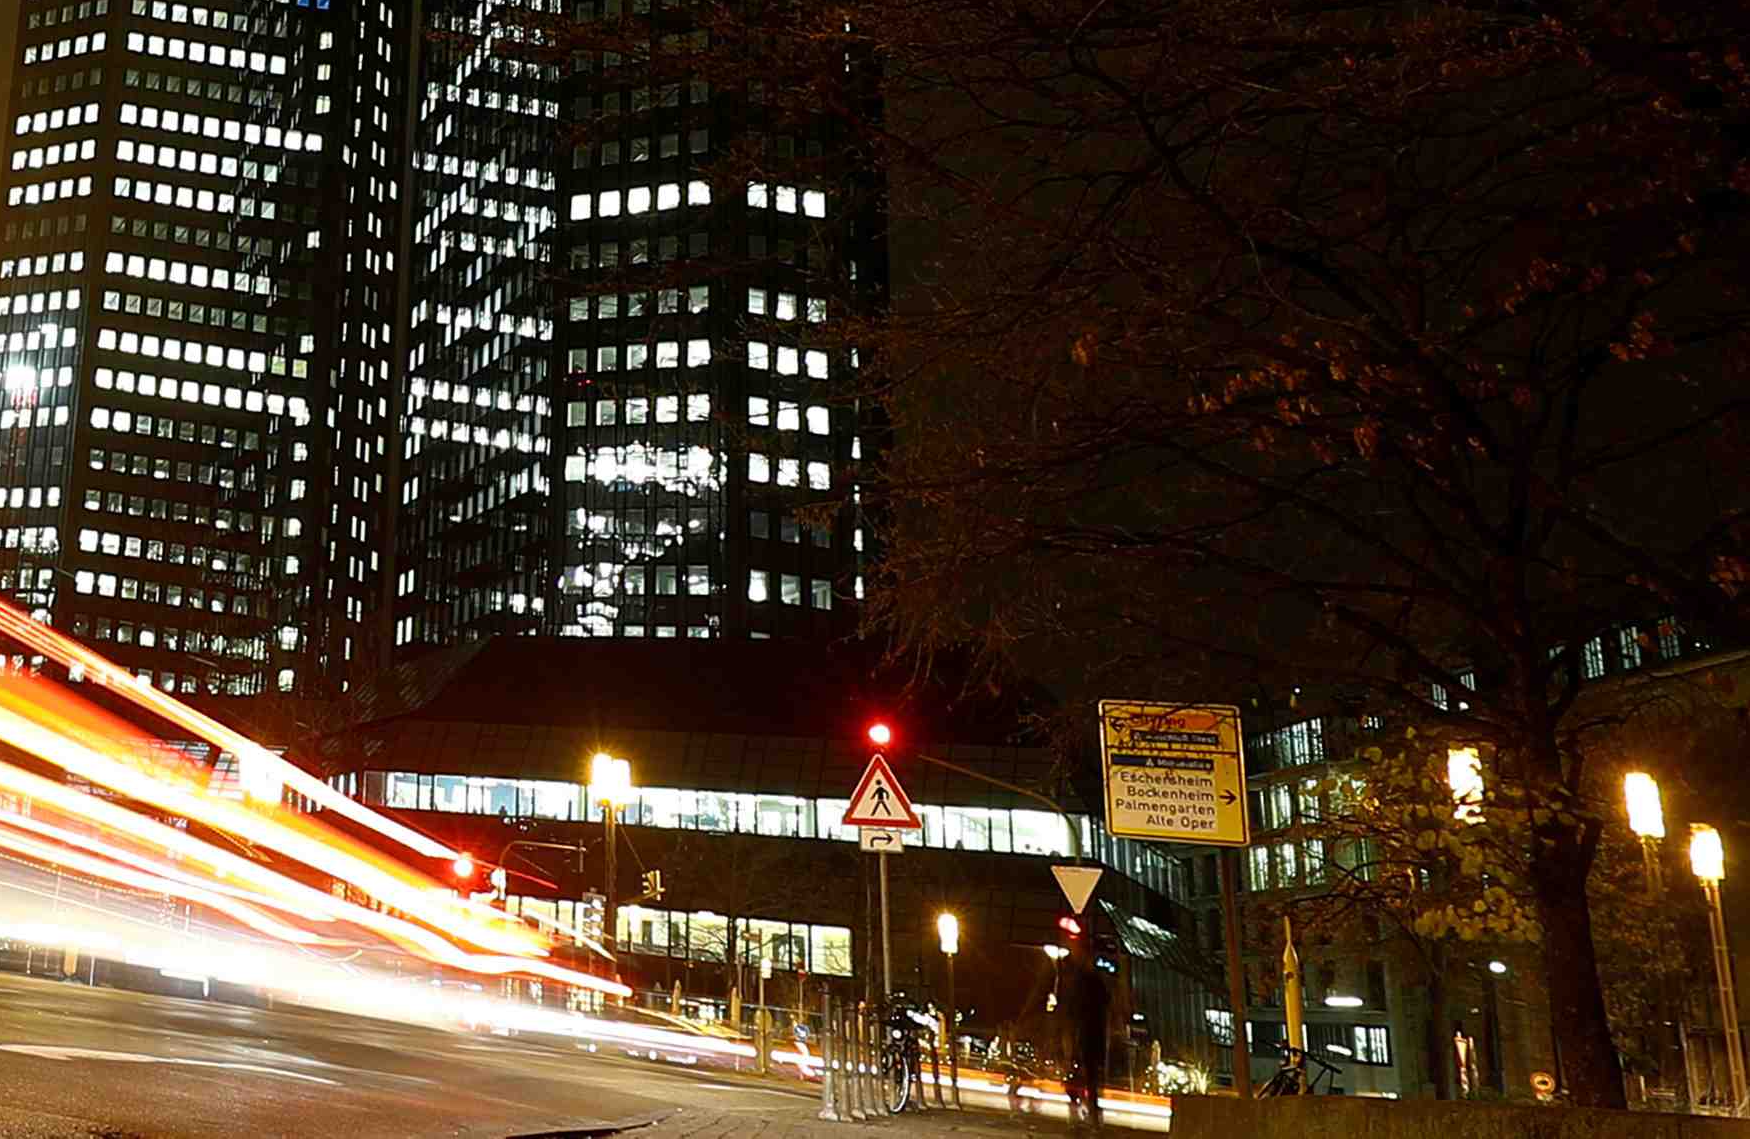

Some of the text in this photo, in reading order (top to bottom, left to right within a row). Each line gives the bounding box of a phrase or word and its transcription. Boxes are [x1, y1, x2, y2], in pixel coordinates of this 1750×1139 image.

[1120, 771, 1213, 786] Eschersheim
[1127, 785, 1214, 801] Bockenheim
[1115, 798, 1215, 815] Palmengarten
[1146, 815, 1215, 830] Alte Oper
